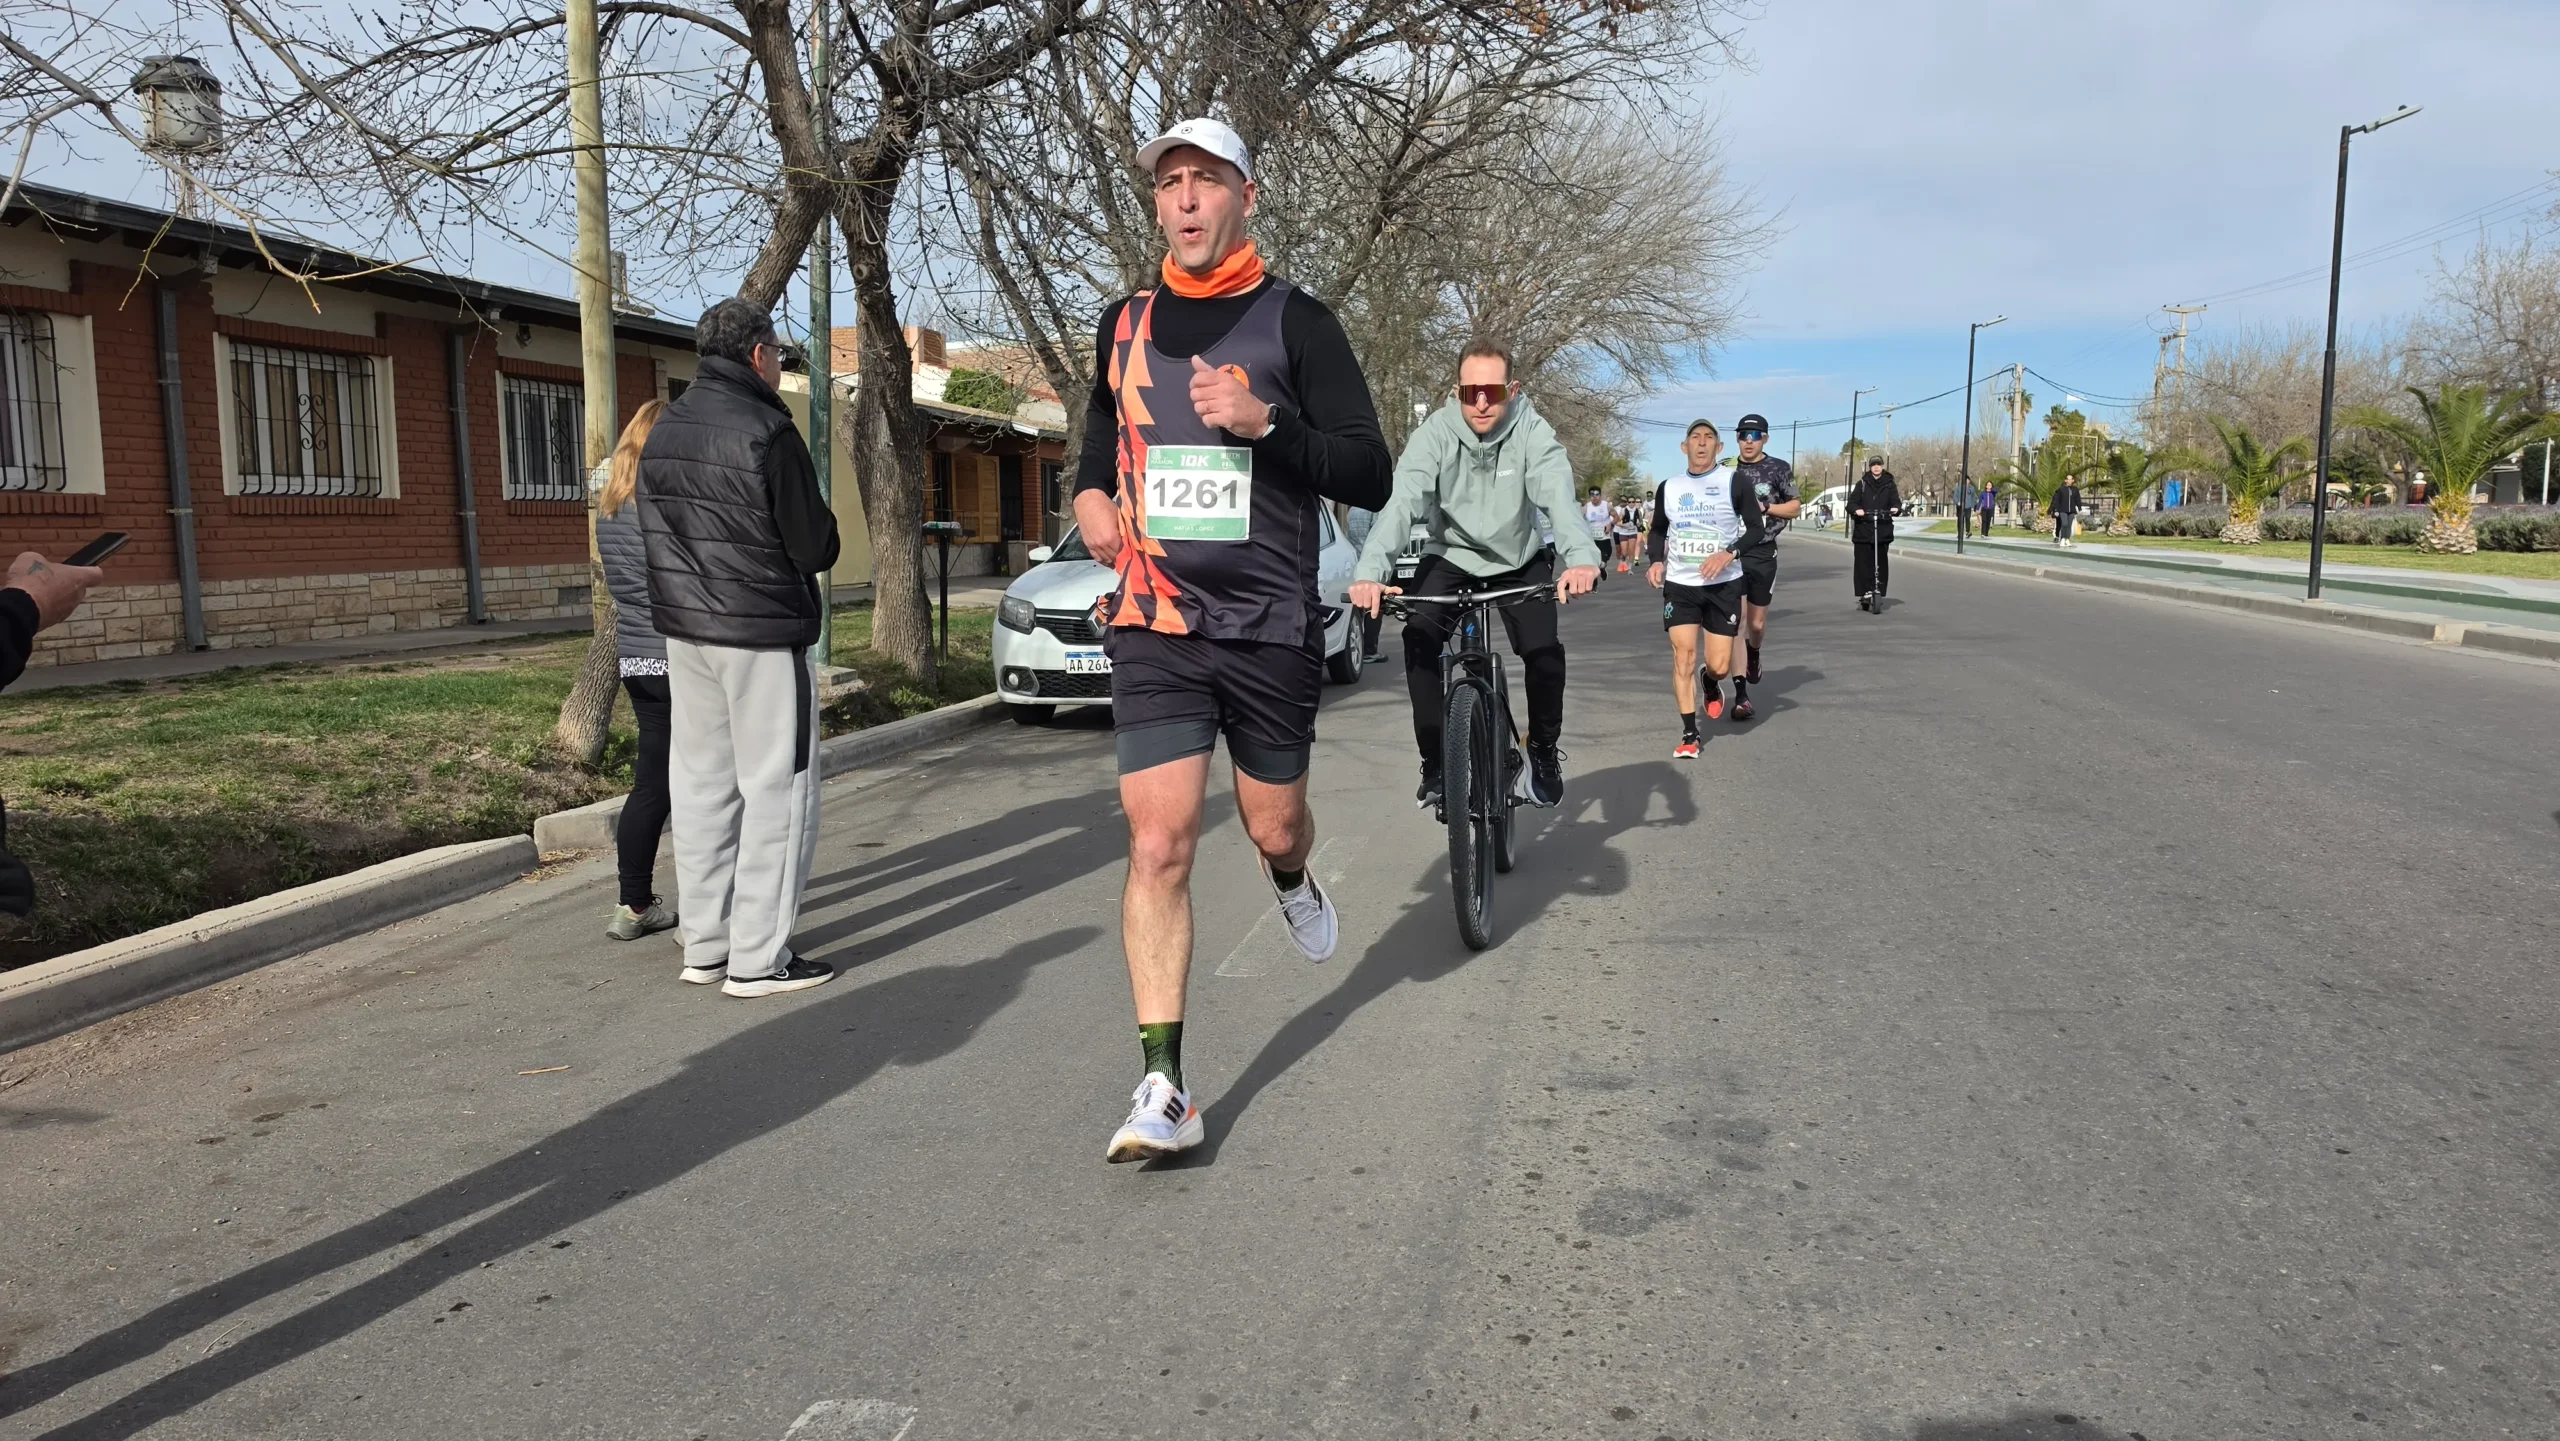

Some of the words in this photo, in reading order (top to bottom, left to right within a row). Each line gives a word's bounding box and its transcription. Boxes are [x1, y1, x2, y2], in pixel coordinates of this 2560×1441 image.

[1180, 455, 1209, 467] 10K
[1153, 478, 1237, 509] 1261
[1680, 541, 1715, 553] 1149
[1070, 660, 1083, 671] AA
[1088, 659, 1109, 671] 264
